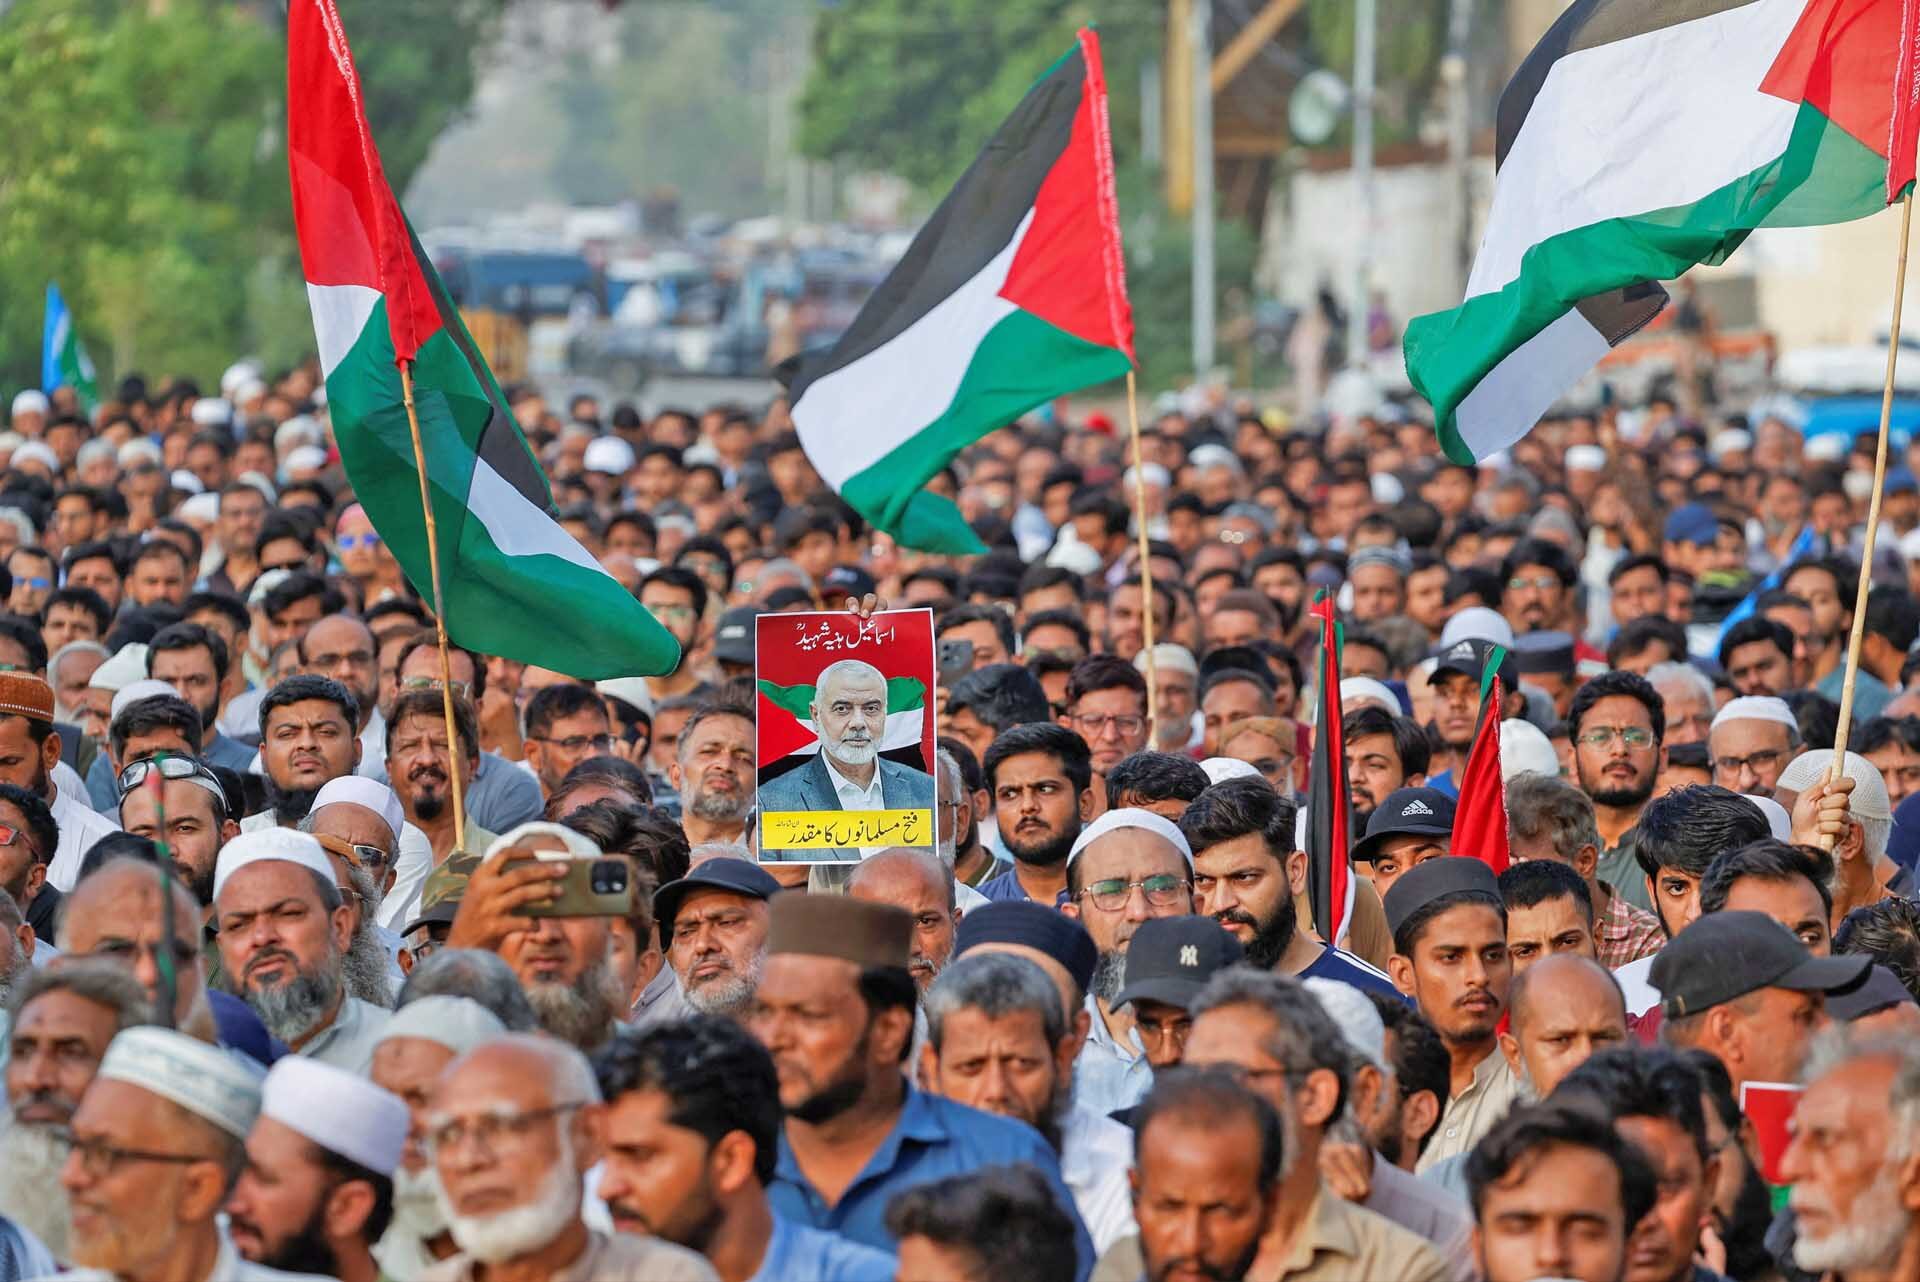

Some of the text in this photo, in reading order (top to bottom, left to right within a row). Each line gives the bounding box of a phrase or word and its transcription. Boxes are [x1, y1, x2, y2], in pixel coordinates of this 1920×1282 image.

[846, 619, 894, 648] اسماعیل
[787, 812, 919, 846] فتح مسلمانوں کا مقدر
